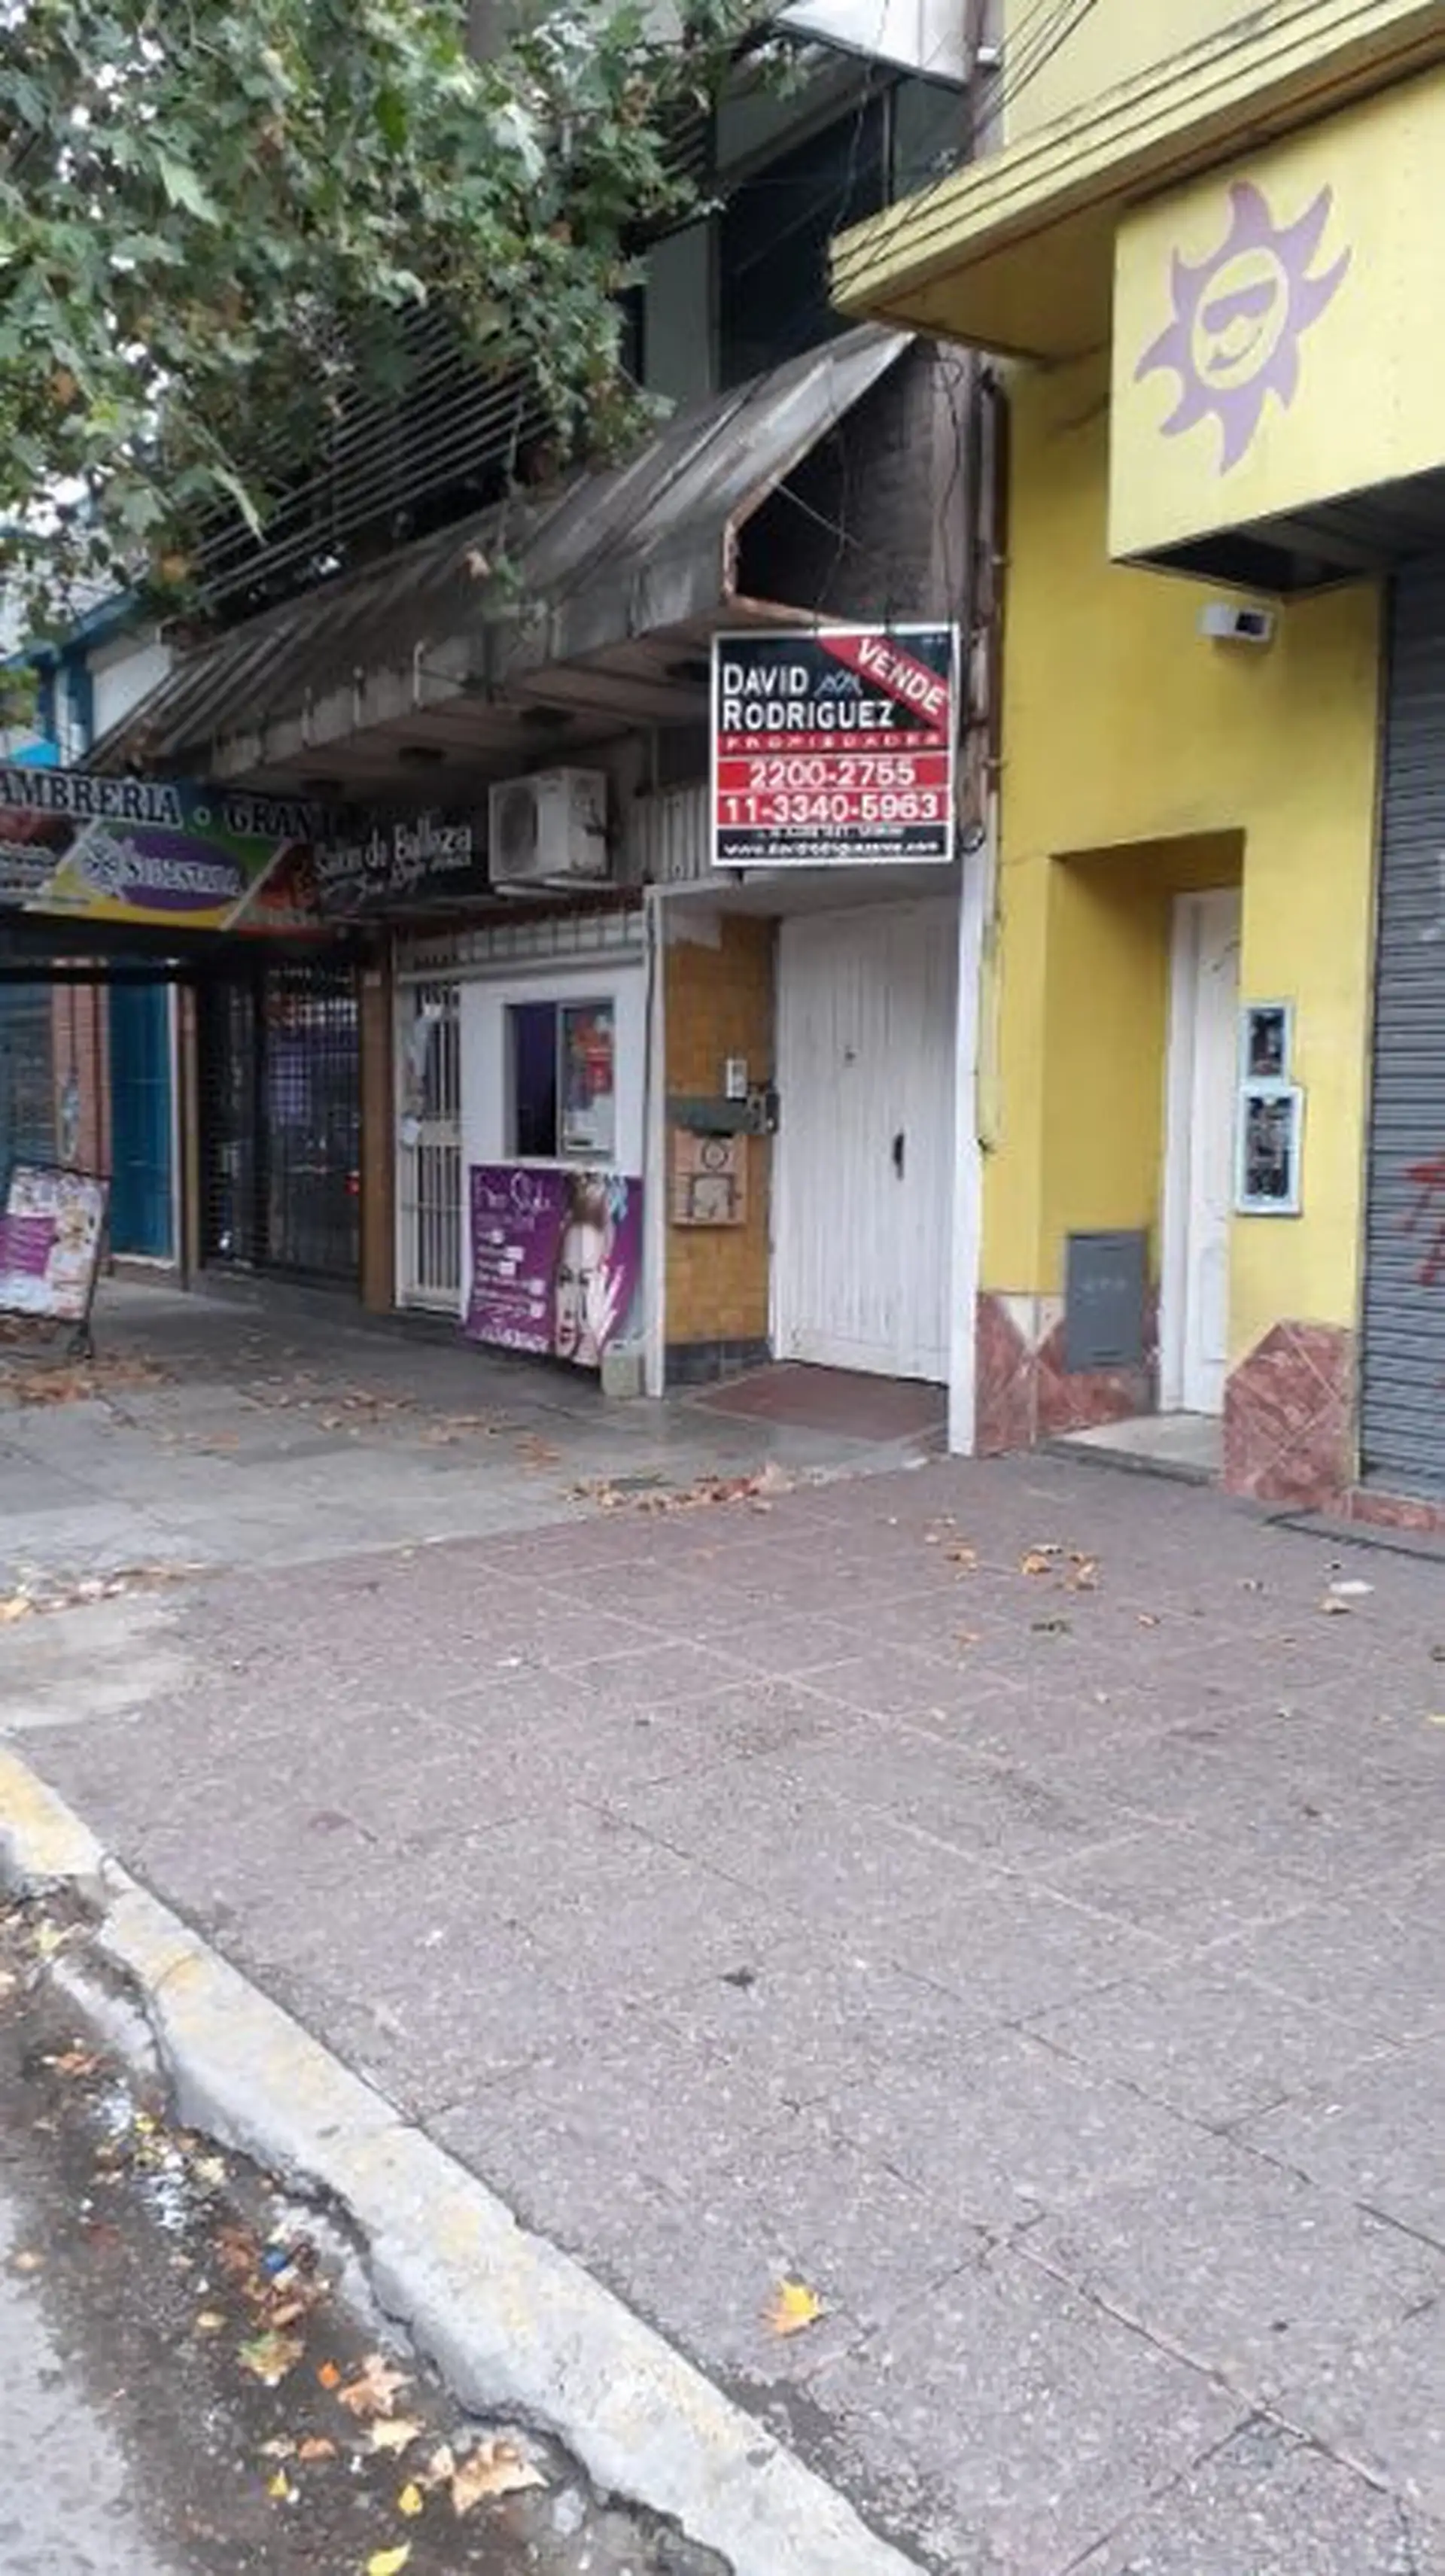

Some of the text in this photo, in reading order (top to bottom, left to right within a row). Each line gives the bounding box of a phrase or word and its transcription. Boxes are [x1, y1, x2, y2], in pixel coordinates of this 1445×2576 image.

[723, 664, 810, 696] DAVID
[857, 637, 947, 715] VENDE
[722, 700, 894, 730] RODRIGUEZ
[750, 761, 917, 788] 2200-2755
[726, 794, 939, 823] 11-3340-5963
